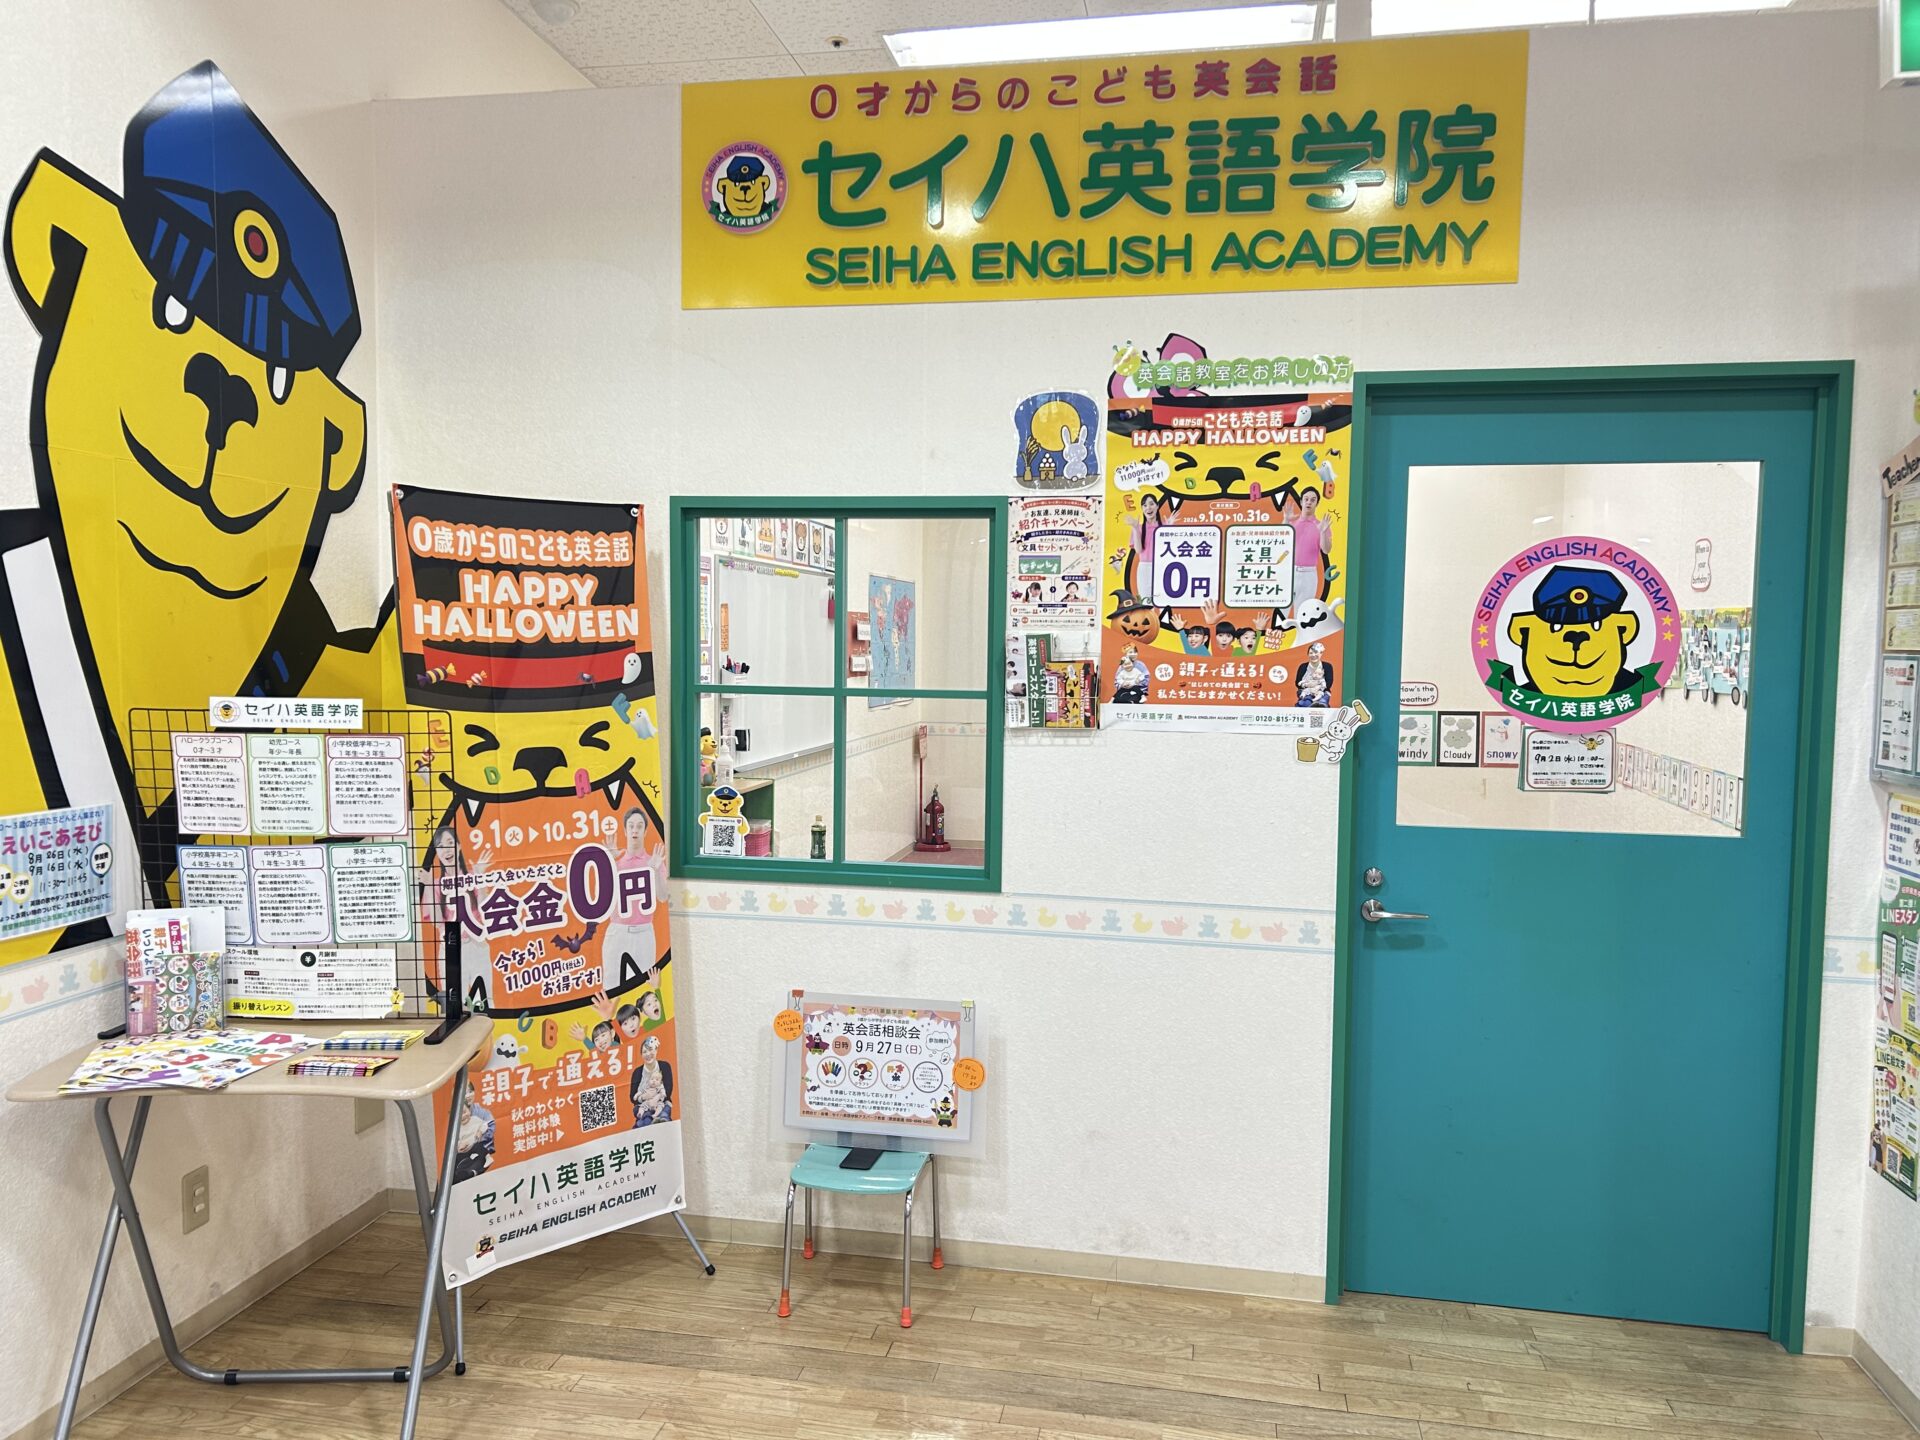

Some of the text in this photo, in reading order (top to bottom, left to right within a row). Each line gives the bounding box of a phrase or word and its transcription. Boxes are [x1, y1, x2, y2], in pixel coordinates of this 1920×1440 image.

[705, 143, 785, 181] SEIHA ENGLISH ACADEMY
[801, 103, 1498, 229] セイハ英語学院
[718, 213, 770, 227] セイハ英語学院
[805, 219, 1491, 287] SEIHA ENGLISH ACADEMY
[1204, 411, 1283, 428] こども英会話
[1132, 428, 1324, 447] HAPPY HALLOWEEN
[1018, 517, 1094, 531] 紹介キャンペーン
[412, 521, 630, 563] 0歳からのこども英会話
[1160, 540, 1213, 558] 入会金
[1234, 538, 1286, 546] セイハオリジナル
[1242, 546, 1273, 563] 文具
[1162, 561, 1211, 599] 0円
[1237, 565, 1276, 579] セット
[463, 573, 595, 607] HAPPY
[1232, 584, 1284, 596] プレゼント
[1477, 542, 1672, 622] SEIHA ENGLISH ACADEMY
[413, 603, 639, 638] HALLOWEEN
[1179, 661, 1265, 678] 親子で通える!
[1157, 689, 1281, 701] 私たちにおまかせください!
[1400, 695, 1435, 703] weather?
[1508, 687, 1635, 718] セイハ英語学院
[244, 703, 359, 717] セイハ英語学院
[1116, 711, 1173, 720] セイハ英語学院
[332, 740, 392, 748] 小学校低学年コース
[1398, 748, 1429, 760] windy
[1443, 750, 1472, 760] Cloudy
[1486, 751, 1518, 760] snowy
[2, 821, 103, 856] えいごあそび
[442, 864, 565, 891] 期間中にご入会いただくと
[542, 968, 602, 996] お得です!
[232, 1001, 291, 1012] 振り替えレッスン
[861, 1007, 904, 1015] セイハ英語学院
[842, 1022, 921, 1040] 英会話相談会
[206, 1042, 268, 1055] SEIHA
[834, 1041, 849, 1050] 日時
[480, 1045, 634, 1106] 親子で通える!
[510, 1092, 575, 1123] 秋のわくわく
[511, 1112, 562, 1139] 無料体験
[512, 1131, 554, 1154] 実施中!
[472, 1140, 656, 1216] セイハ英語学院
[488, 1170, 647, 1226] SEIHA ENGLISH ACADEMY
[498, 1184, 658, 1244] SEIHA ENGLISH ACADEMY
